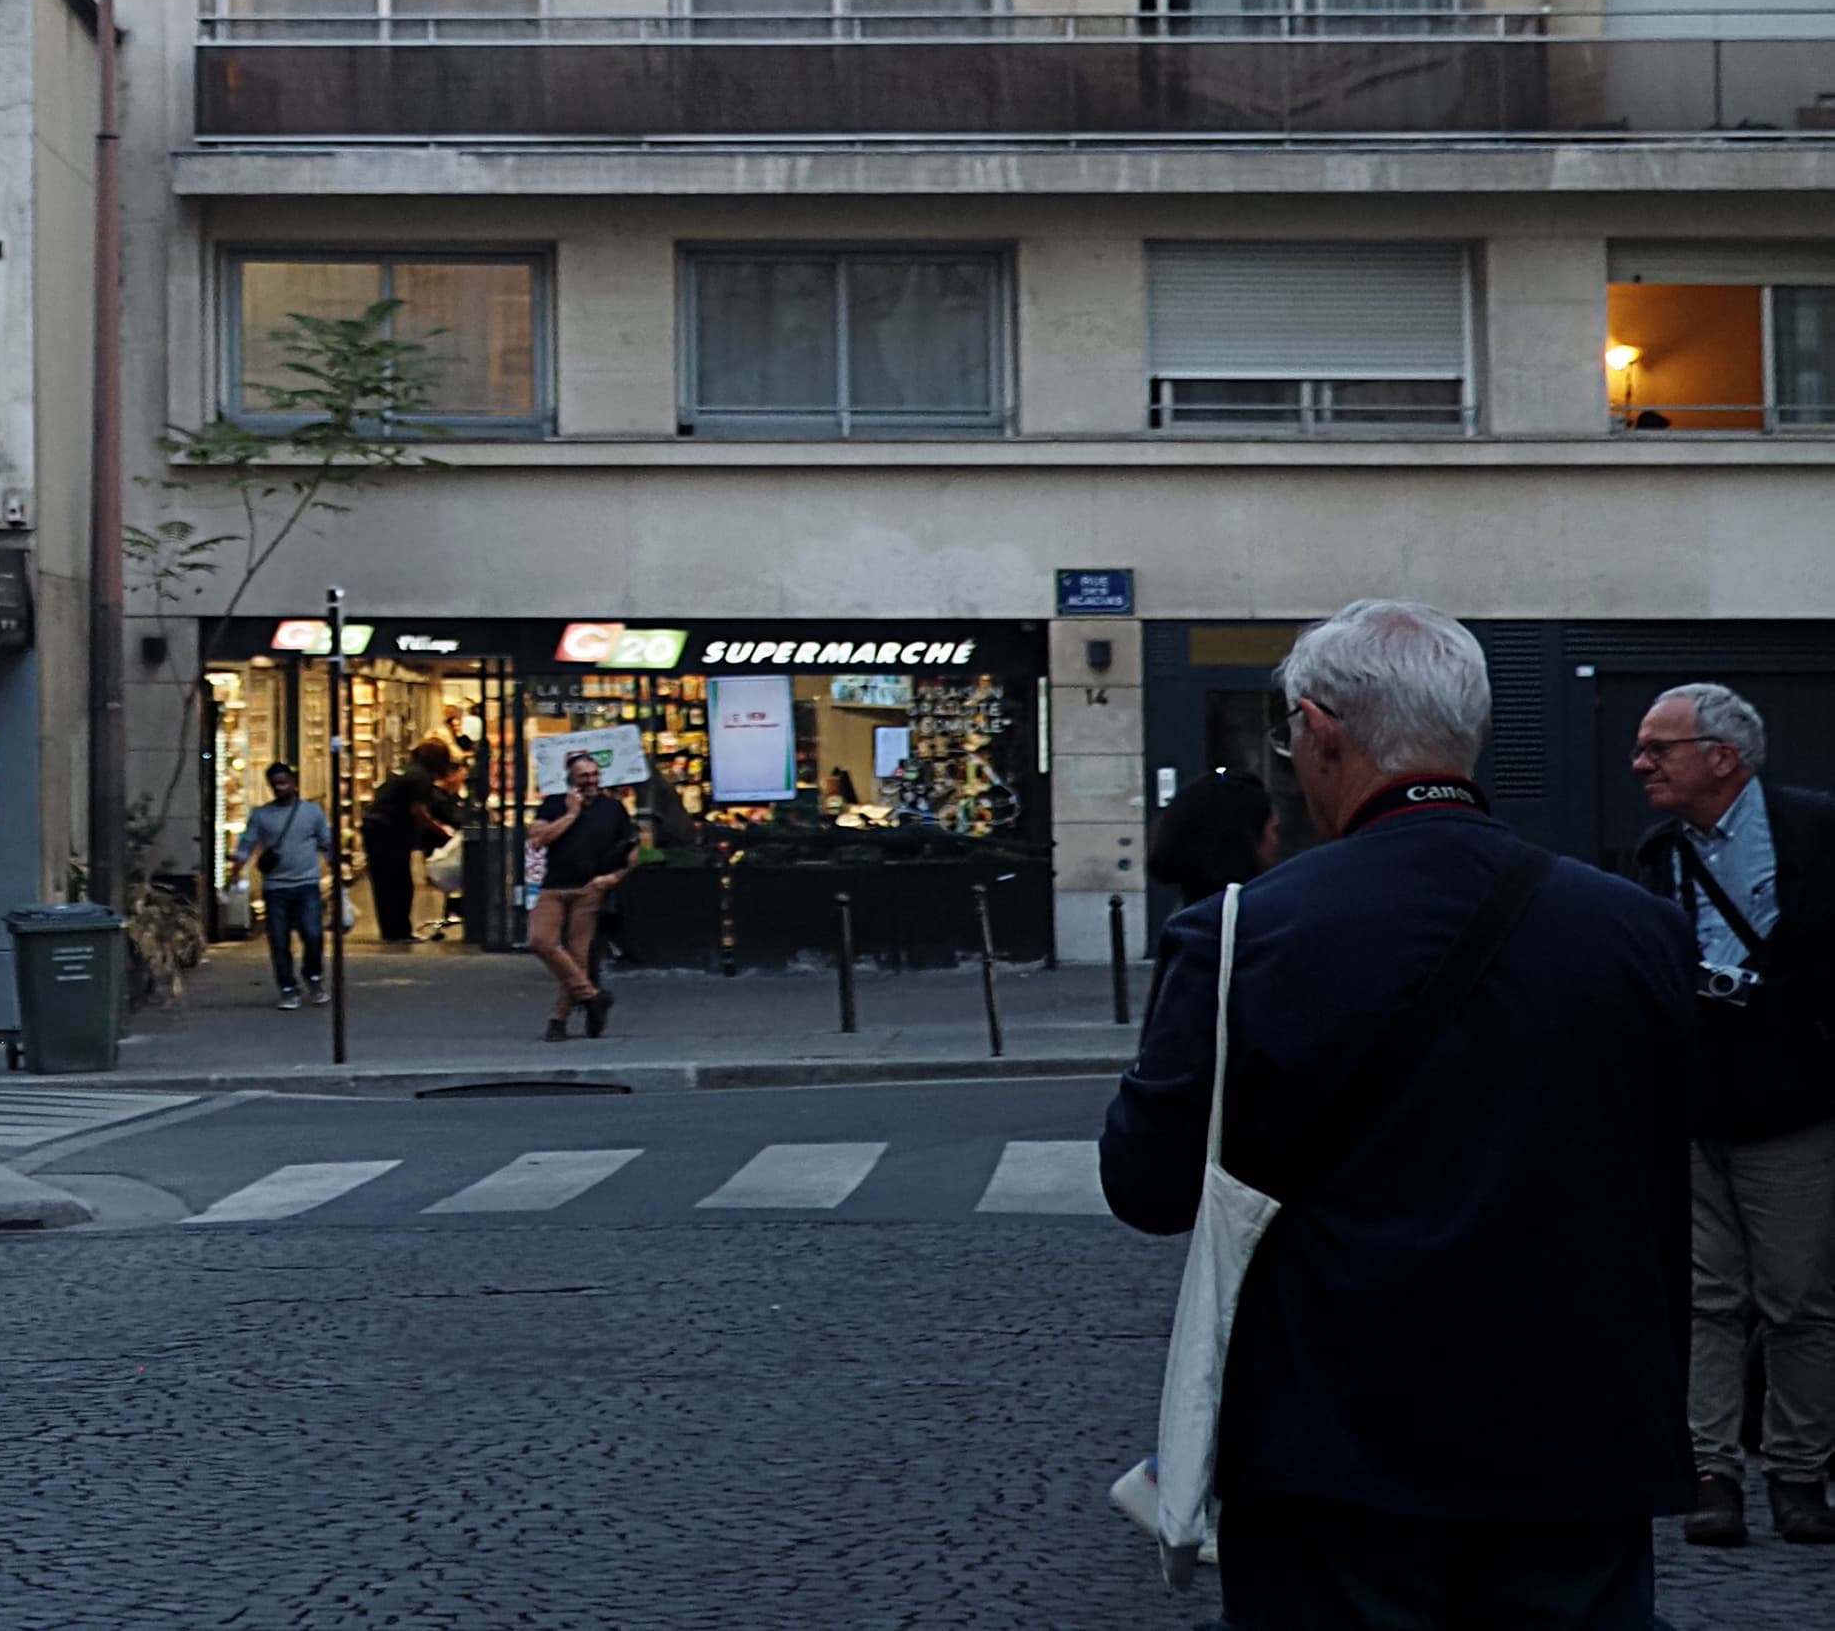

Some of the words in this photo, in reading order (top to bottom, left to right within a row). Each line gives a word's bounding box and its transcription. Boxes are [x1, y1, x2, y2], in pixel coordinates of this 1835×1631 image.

[1079, 575, 1109, 587] RUE
[701, 639, 977, 665] SUPERMARCHÉ
[1086, 689, 1109, 706] 14
